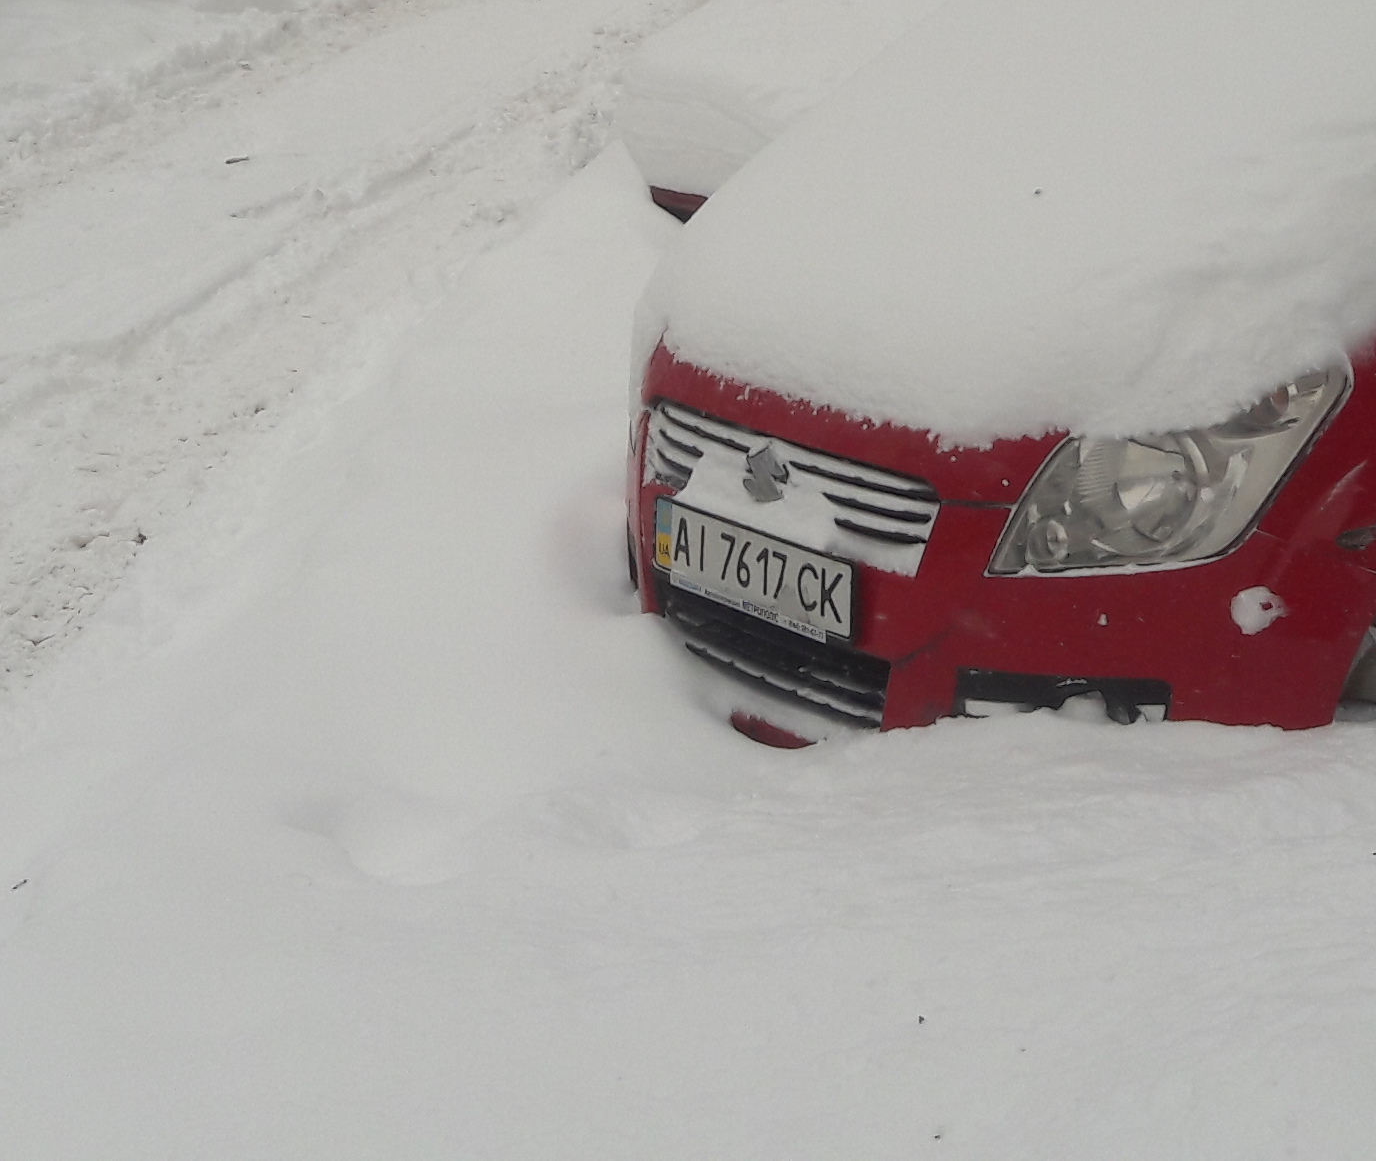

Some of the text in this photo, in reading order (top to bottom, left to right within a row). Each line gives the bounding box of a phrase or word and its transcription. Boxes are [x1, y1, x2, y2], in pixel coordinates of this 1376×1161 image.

[674, 517, 844, 624] AI 7617 CK
